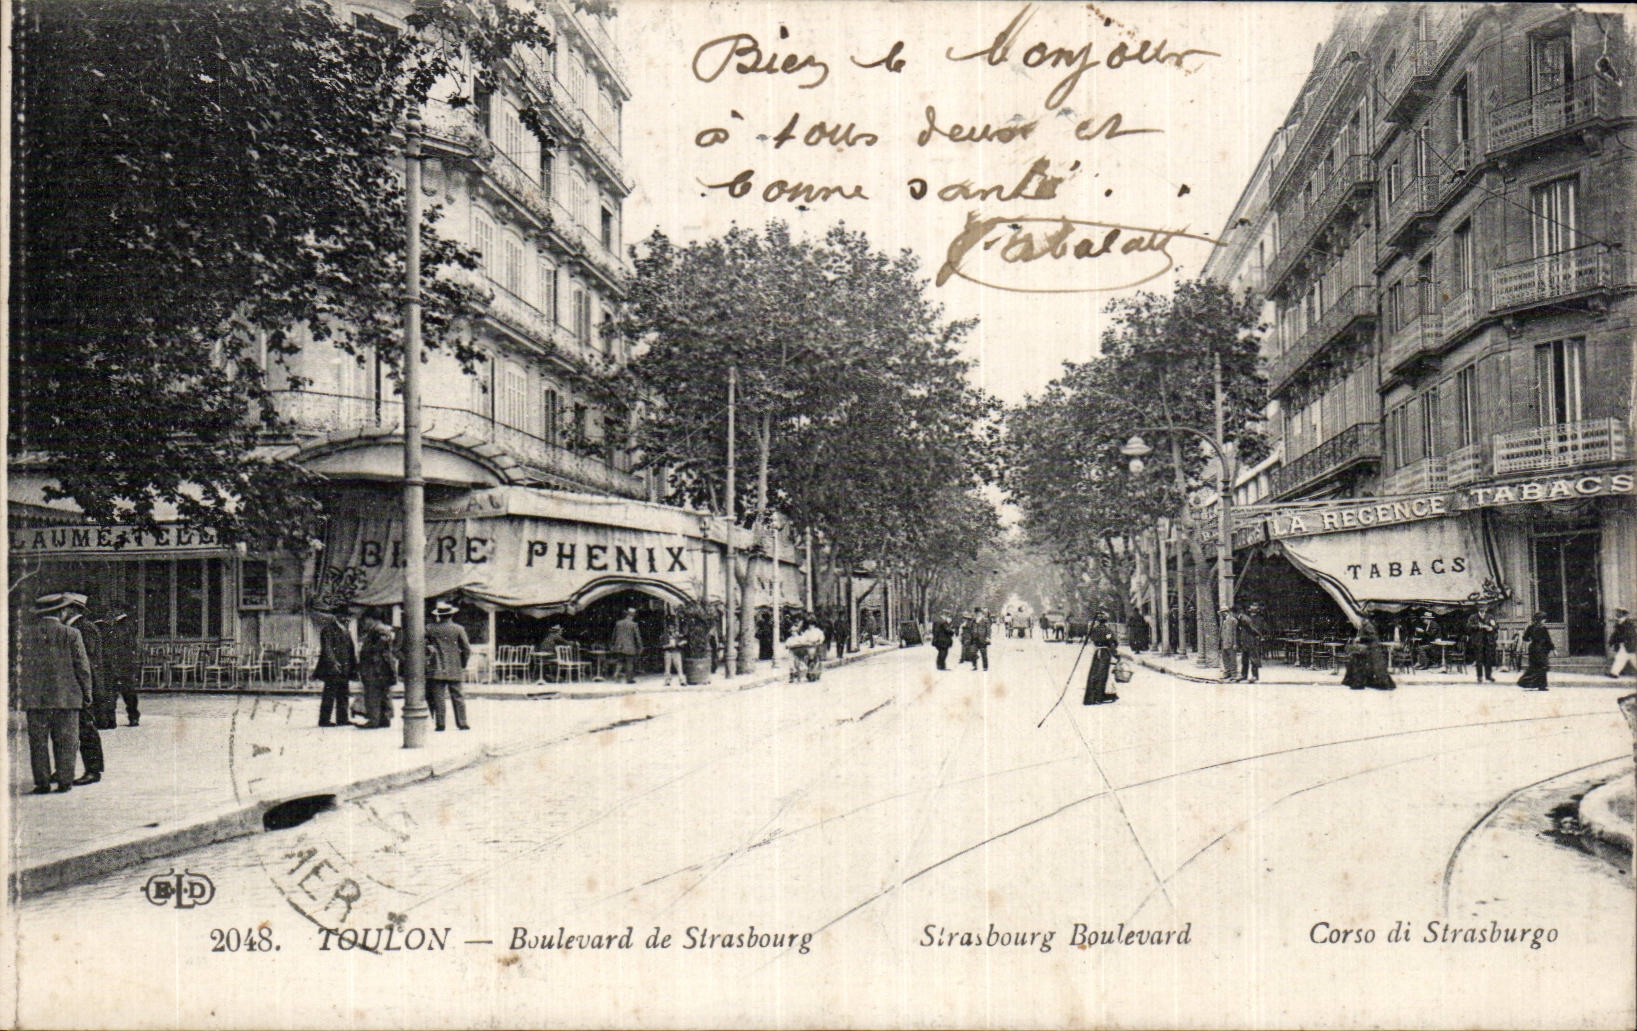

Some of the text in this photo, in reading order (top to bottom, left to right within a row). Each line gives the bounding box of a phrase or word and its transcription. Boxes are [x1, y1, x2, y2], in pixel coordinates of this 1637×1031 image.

[692, 25, 829, 88] Bien
[772, 112, 878, 148] tous
[1471, 474, 1634, 505] TABACS
[1269, 513, 1308, 536] LA
[1322, 495, 1446, 531] REGENCE
[361, 535, 688, 573] BIRE PHENIX
[1347, 557, 1466, 580] TABACS
